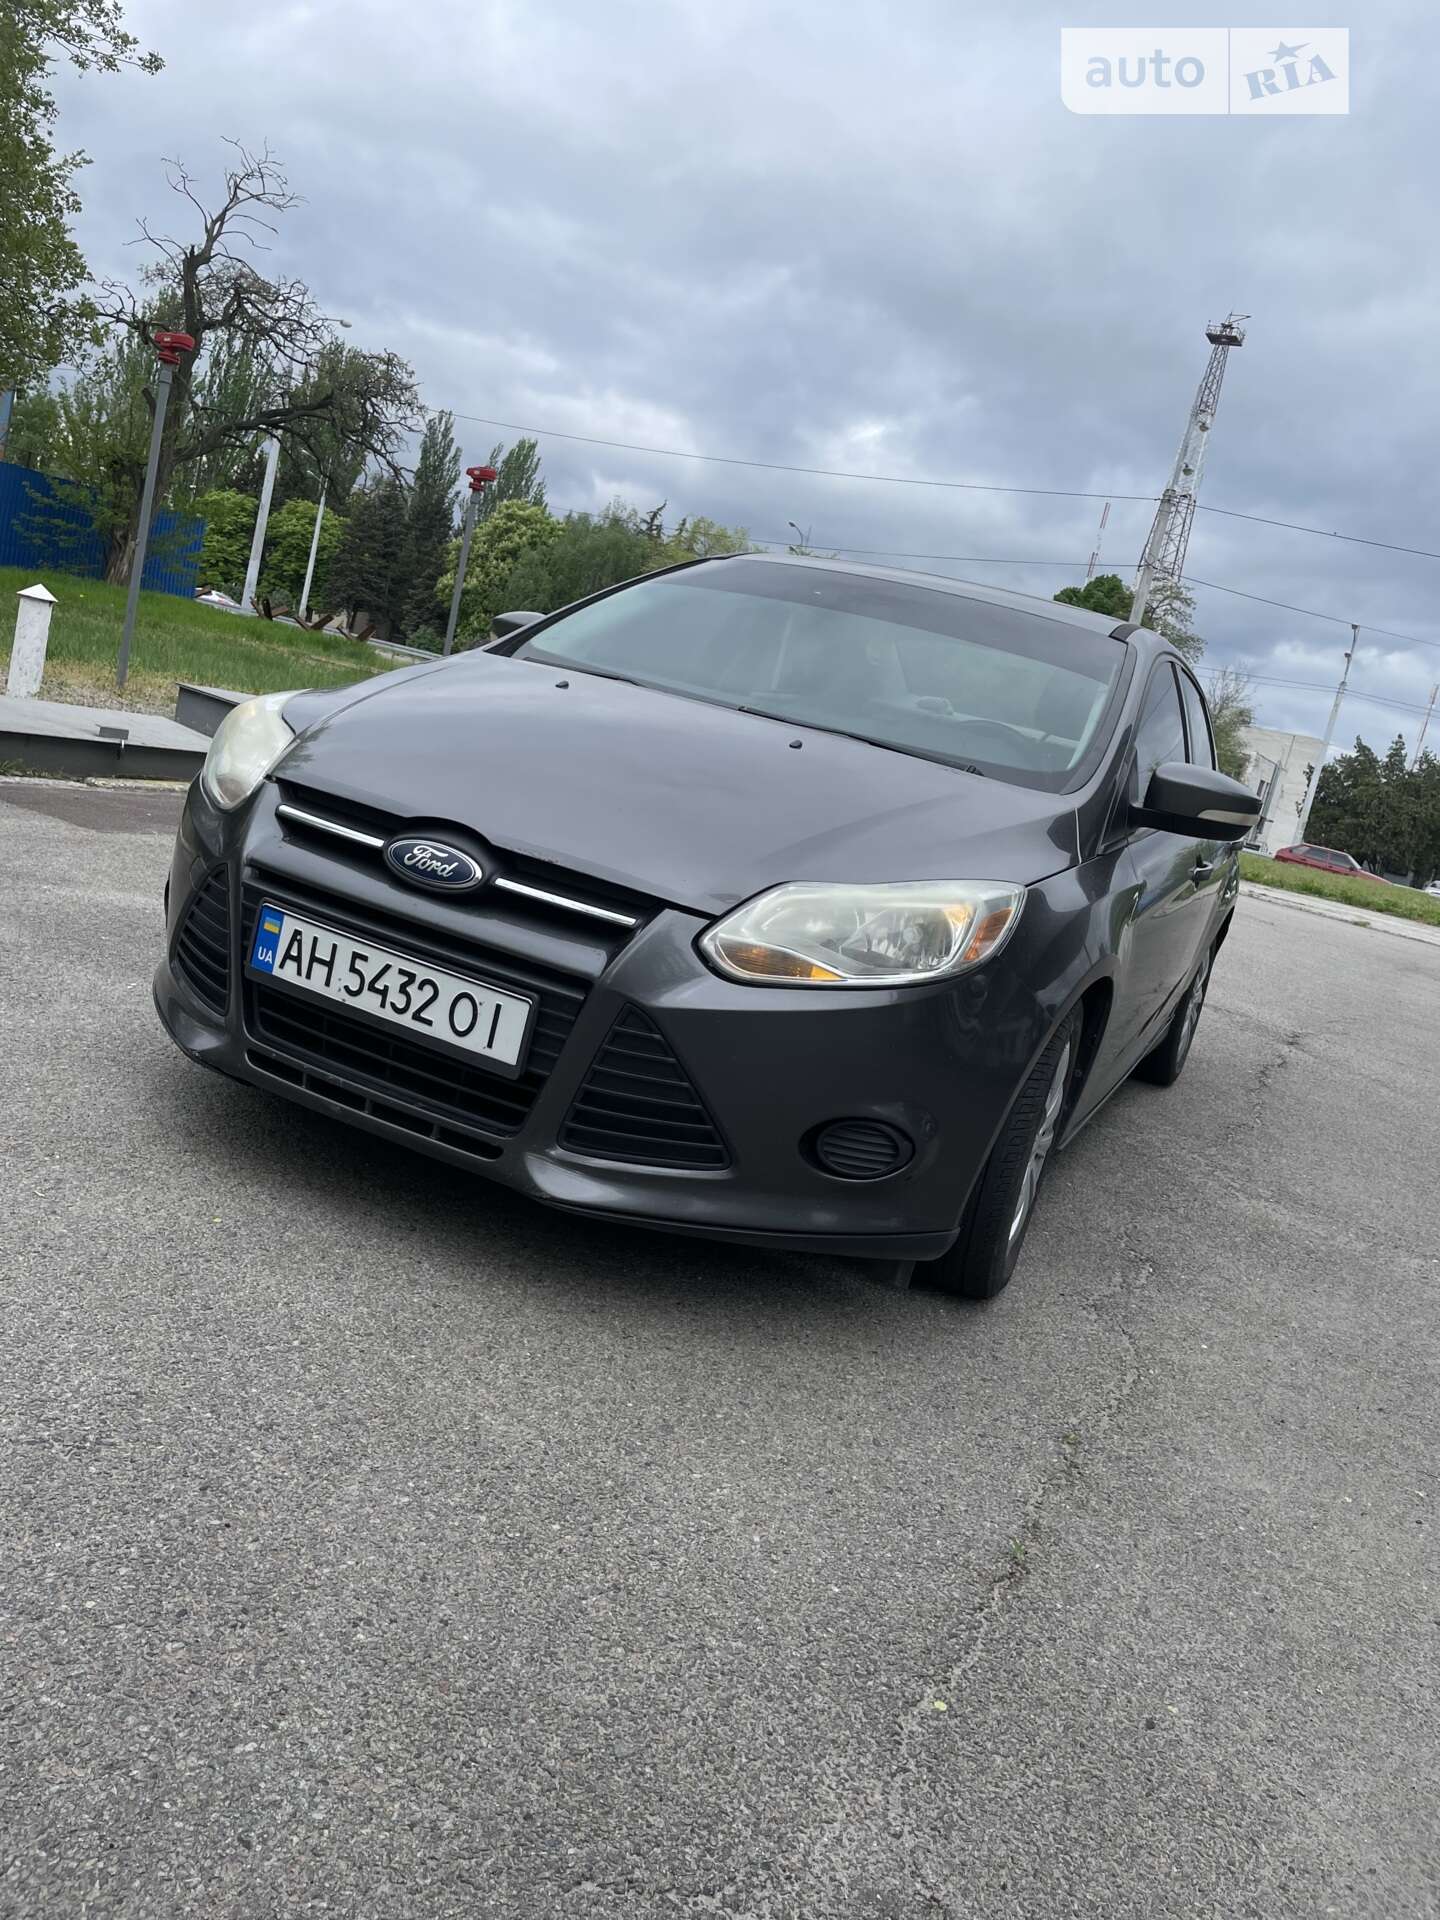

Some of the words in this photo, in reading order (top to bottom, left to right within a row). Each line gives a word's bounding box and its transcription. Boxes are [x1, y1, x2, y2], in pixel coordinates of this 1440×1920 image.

[403, 844, 457, 879] Ford
[257, 945, 273, 965] UA
[278, 929, 338, 987] AH
[343, 951, 440, 1026] 5432
[448, 991, 503, 1049] OI
